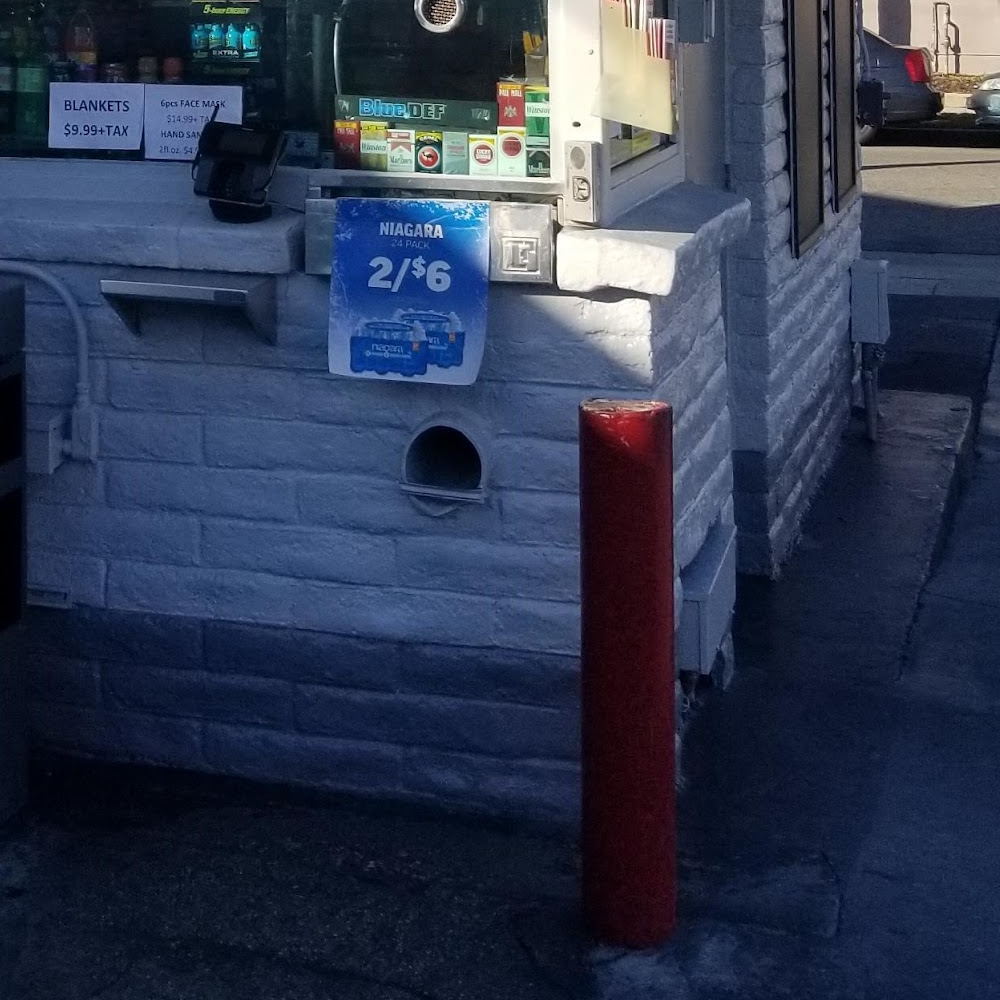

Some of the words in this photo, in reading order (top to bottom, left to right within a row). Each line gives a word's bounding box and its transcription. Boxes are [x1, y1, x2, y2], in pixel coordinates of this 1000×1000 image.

[64, 99, 130, 113] BLANKETS
[160, 99, 178, 108] 6pcs
[63, 123, 129, 139] $9.99+TAX
[379, 221, 444, 239] NIAGARA
[390, 239, 403, 247] 24
[405, 240, 430, 250] PACK
[367, 255, 451, 293] 2/$6
